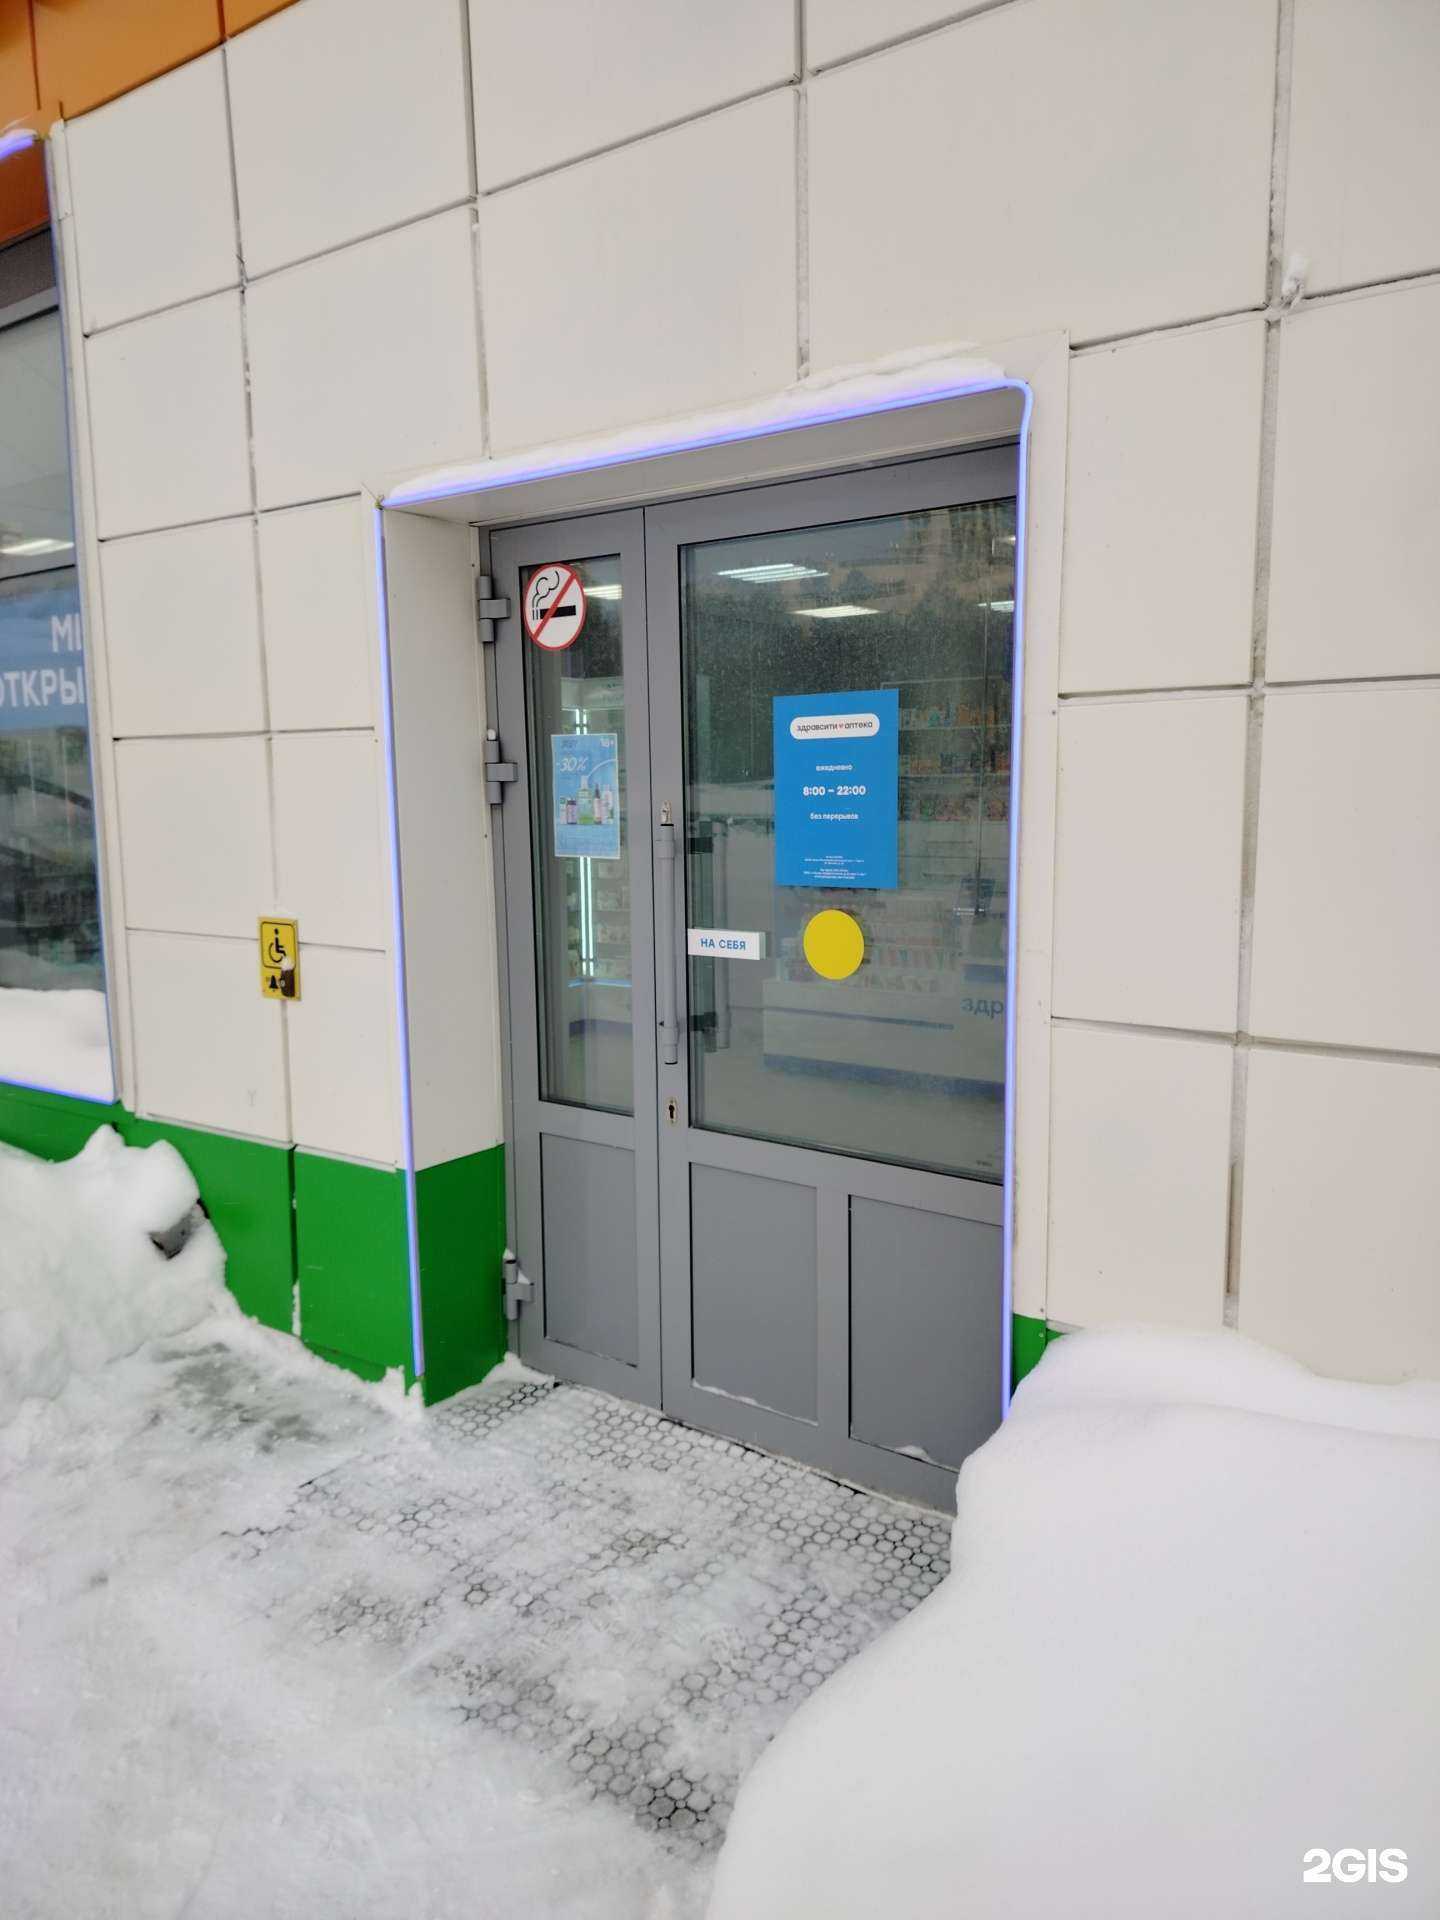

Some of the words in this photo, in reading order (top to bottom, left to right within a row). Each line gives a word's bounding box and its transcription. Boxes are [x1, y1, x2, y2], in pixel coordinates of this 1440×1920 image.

[797, 723, 837, 734] здравсити
[844, 721, 873, 730] аптека
[815, 763, 853, 772] ежедневно
[803, 786, 825, 797] 8:00
[836, 784, 867, 796] 22:00
[810, 811, 822, 820] без
[700, 938, 716, 949] НА
[718, 938, 746, 951] СЕБЯ
